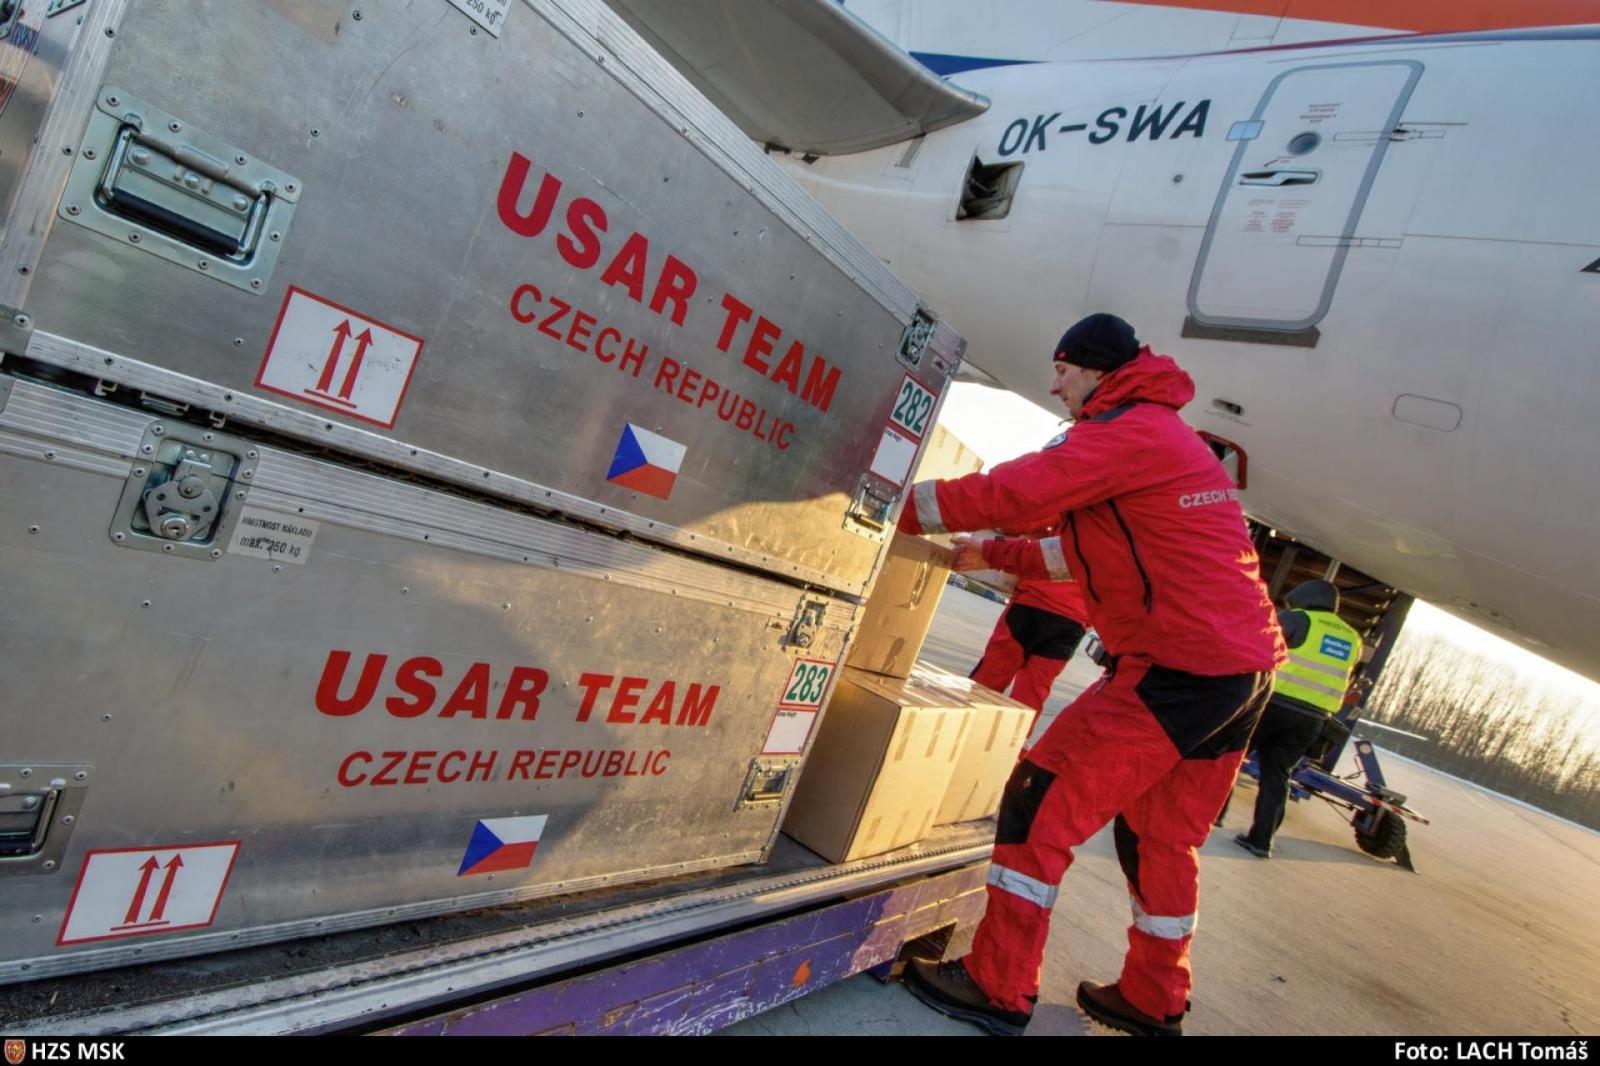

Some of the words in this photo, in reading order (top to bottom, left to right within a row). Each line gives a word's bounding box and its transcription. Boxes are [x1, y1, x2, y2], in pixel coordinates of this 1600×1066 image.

[998, 99, 1211, 156] OK-SWA
[497, 151, 698, 327] USAR
[716, 293, 842, 413] TEAM
[510, 284, 648, 378] CZECH
[654, 357, 795, 450] REPUBLIC
[893, 381, 932, 434] 282
[1179, 489, 1226, 508] CZECH
[267, 540, 287, 553] 250
[289, 545, 301, 557] kg
[315, 650, 549, 721] USAR
[575, 672, 720, 727] TEAM
[786, 663, 828, 702] 283
[337, 750, 498, 787] CZECH
[507, 749, 671, 780] REPUBLIC
